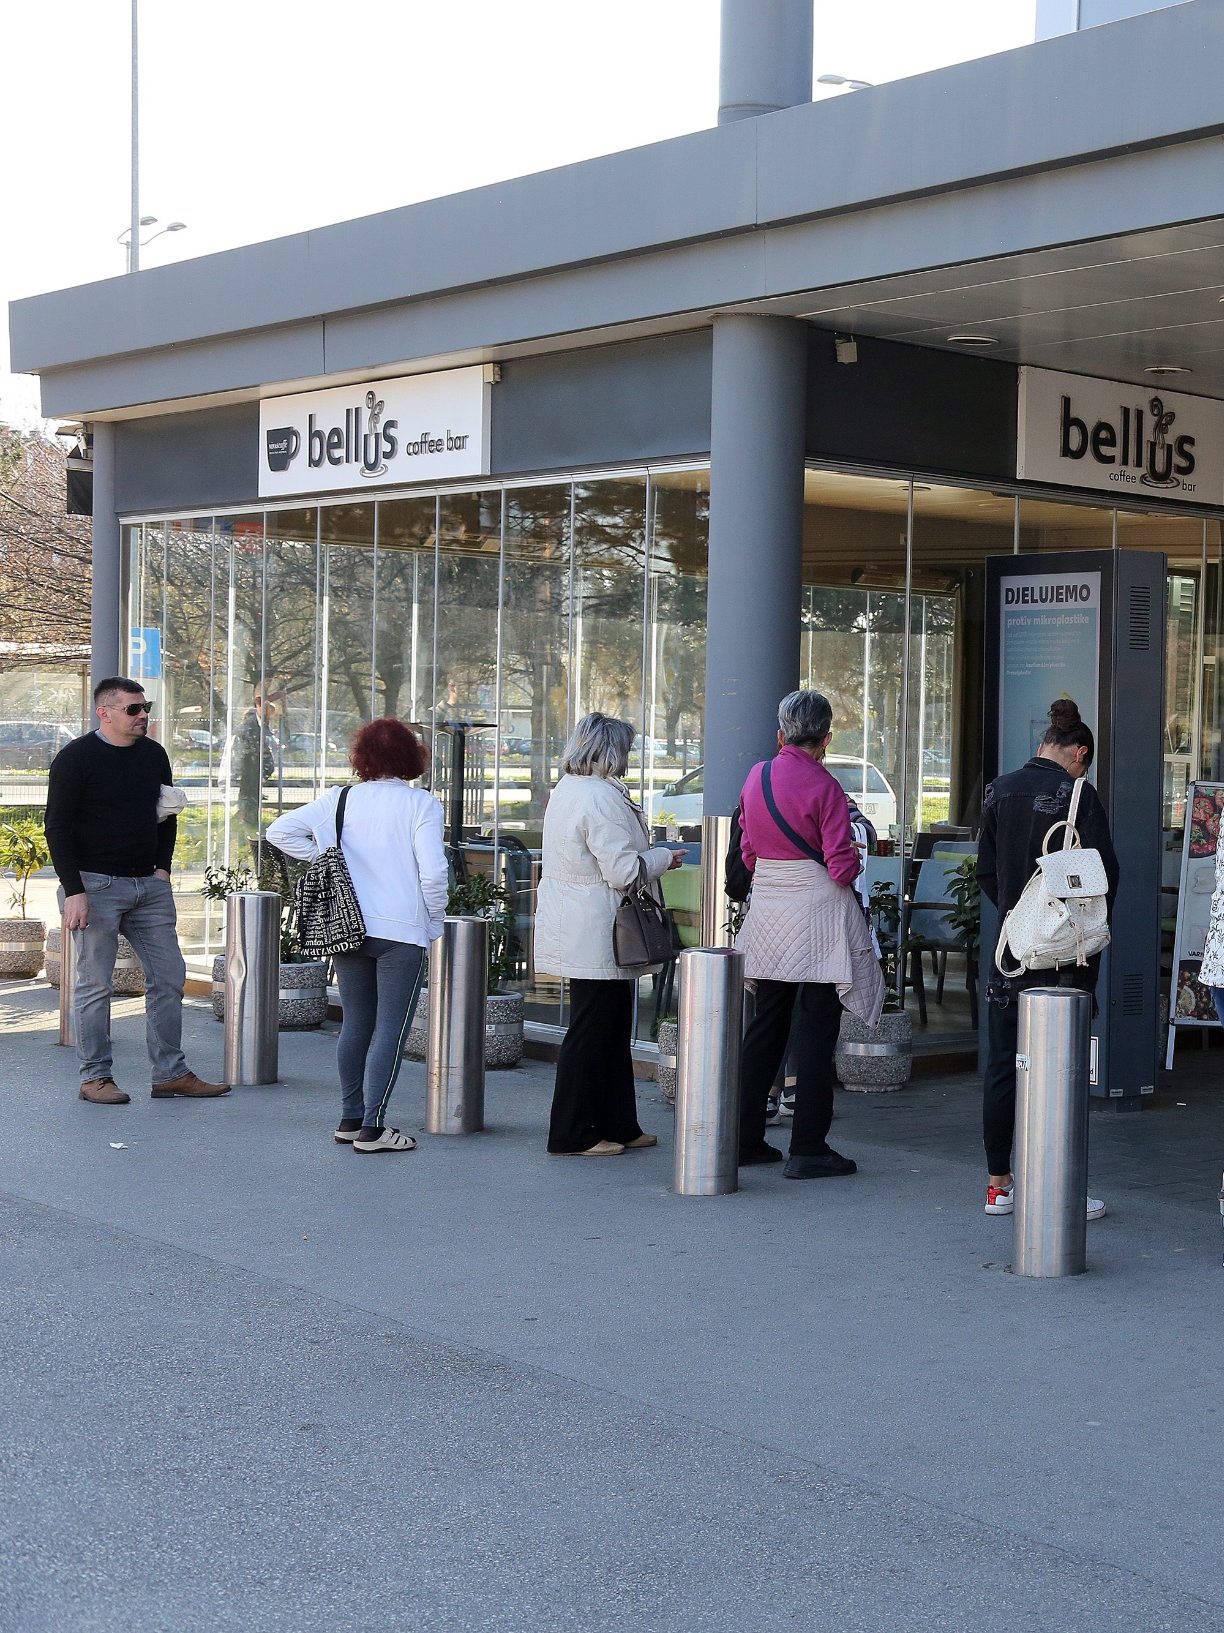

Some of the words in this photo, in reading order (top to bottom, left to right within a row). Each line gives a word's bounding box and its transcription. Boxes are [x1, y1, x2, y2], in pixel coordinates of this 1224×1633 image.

[308, 406, 399, 472] bellus
[406, 432, 444, 456] coffee
[446, 429, 470, 451] bar
[1060, 394, 1196, 482] bellus
[1109, 470, 1137, 484] coffee
[1182, 479, 1197, 492] bar
[1005, 584, 1091, 605] DJELUJEMO
[1007, 615, 1031, 629] protiv
[1033, 613, 1089, 627] mikroplastike
